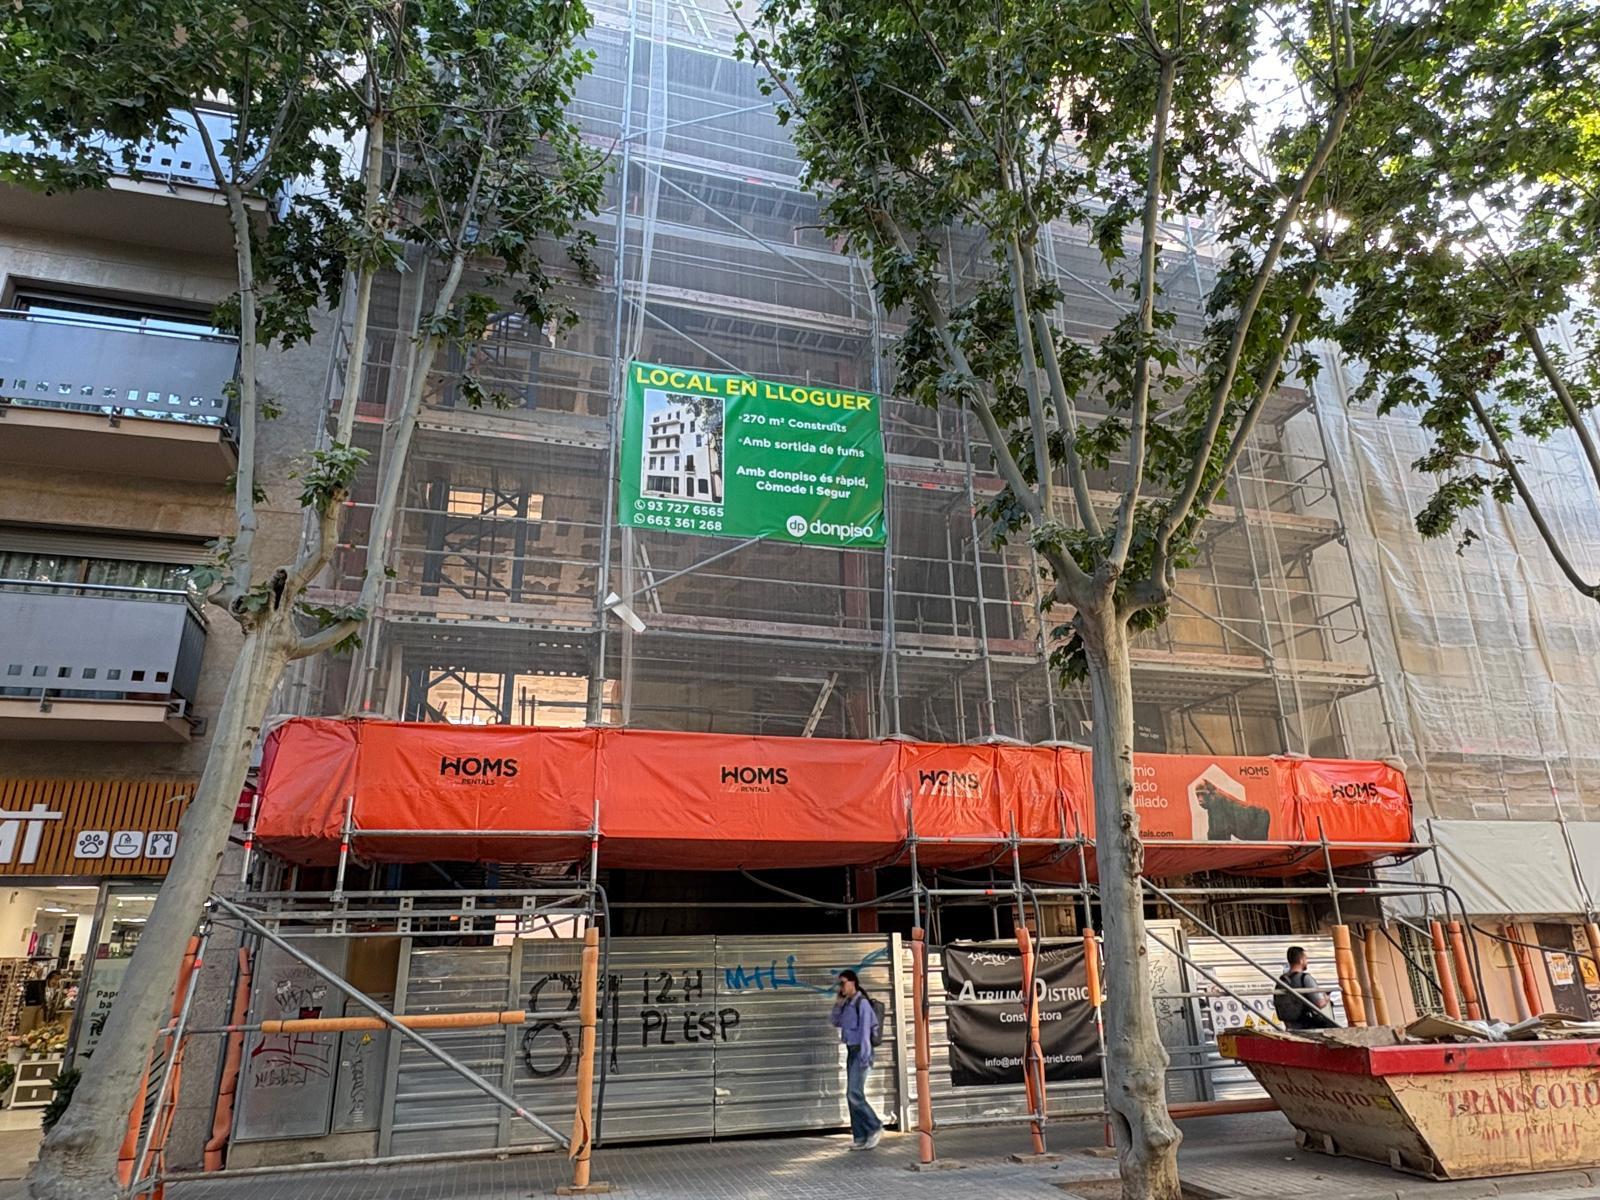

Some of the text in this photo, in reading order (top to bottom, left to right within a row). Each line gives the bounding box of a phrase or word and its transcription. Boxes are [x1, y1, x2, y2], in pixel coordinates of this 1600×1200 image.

[637, 367, 870, 411] LOCAL EN LLOGUER
[774, 441, 816, 454] sortida
[819, 444, 834, 455] de
[837, 445, 865, 458] fums
[736, 465, 869, 489] Amb donpiso és ràpid,
[755, 480, 807, 495] Còmode
[816, 485, 851, 500] Segur
[647, 500, 725, 517] 93 727 6565
[646, 514, 723, 531] 663 361 268
[809, 519, 874, 540] donpiso
[440, 756, 519, 777] HOMS
[721, 766, 789, 785] HOMS
[1239, 766, 1270, 777] HOMS
[461, 778, 495, 786] RENTALS
[918, 769, 980, 790] HOMS
[1331, 782, 1379, 799] HOMS
